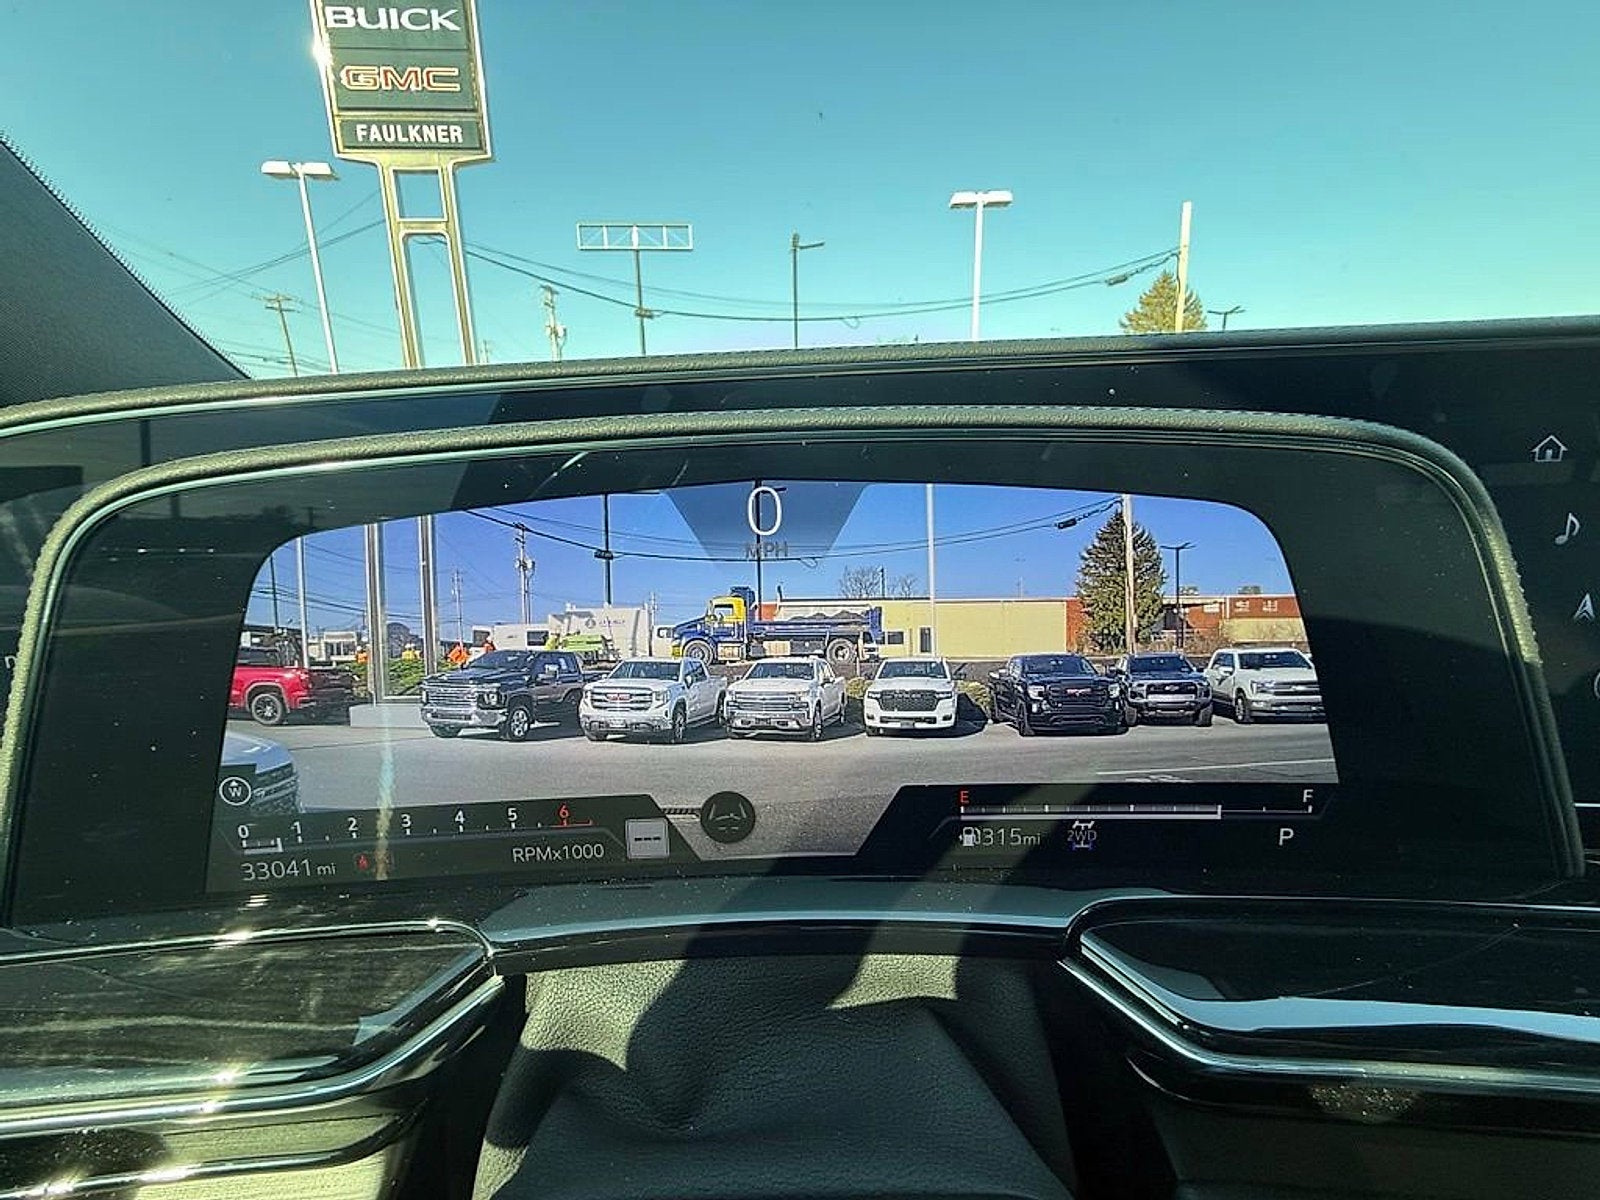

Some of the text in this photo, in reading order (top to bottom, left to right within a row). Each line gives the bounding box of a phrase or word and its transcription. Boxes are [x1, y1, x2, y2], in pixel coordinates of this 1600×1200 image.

[324, 5, 462, 31] BUICK
[340, 65, 461, 92] GMC
[355, 123, 464, 144] FAULKNER
[747, 486, 782, 536] 0
[746, 541, 790, 560] MPH
[228, 786, 243, 798] W
[960, 790, 970, 804] E
[1302, 788, 1314, 803] F
[237, 803, 570, 839] 0 1 2 3 4 5 6
[1278, 827, 1295, 846] P
[241, 858, 337, 881] 33041 mi
